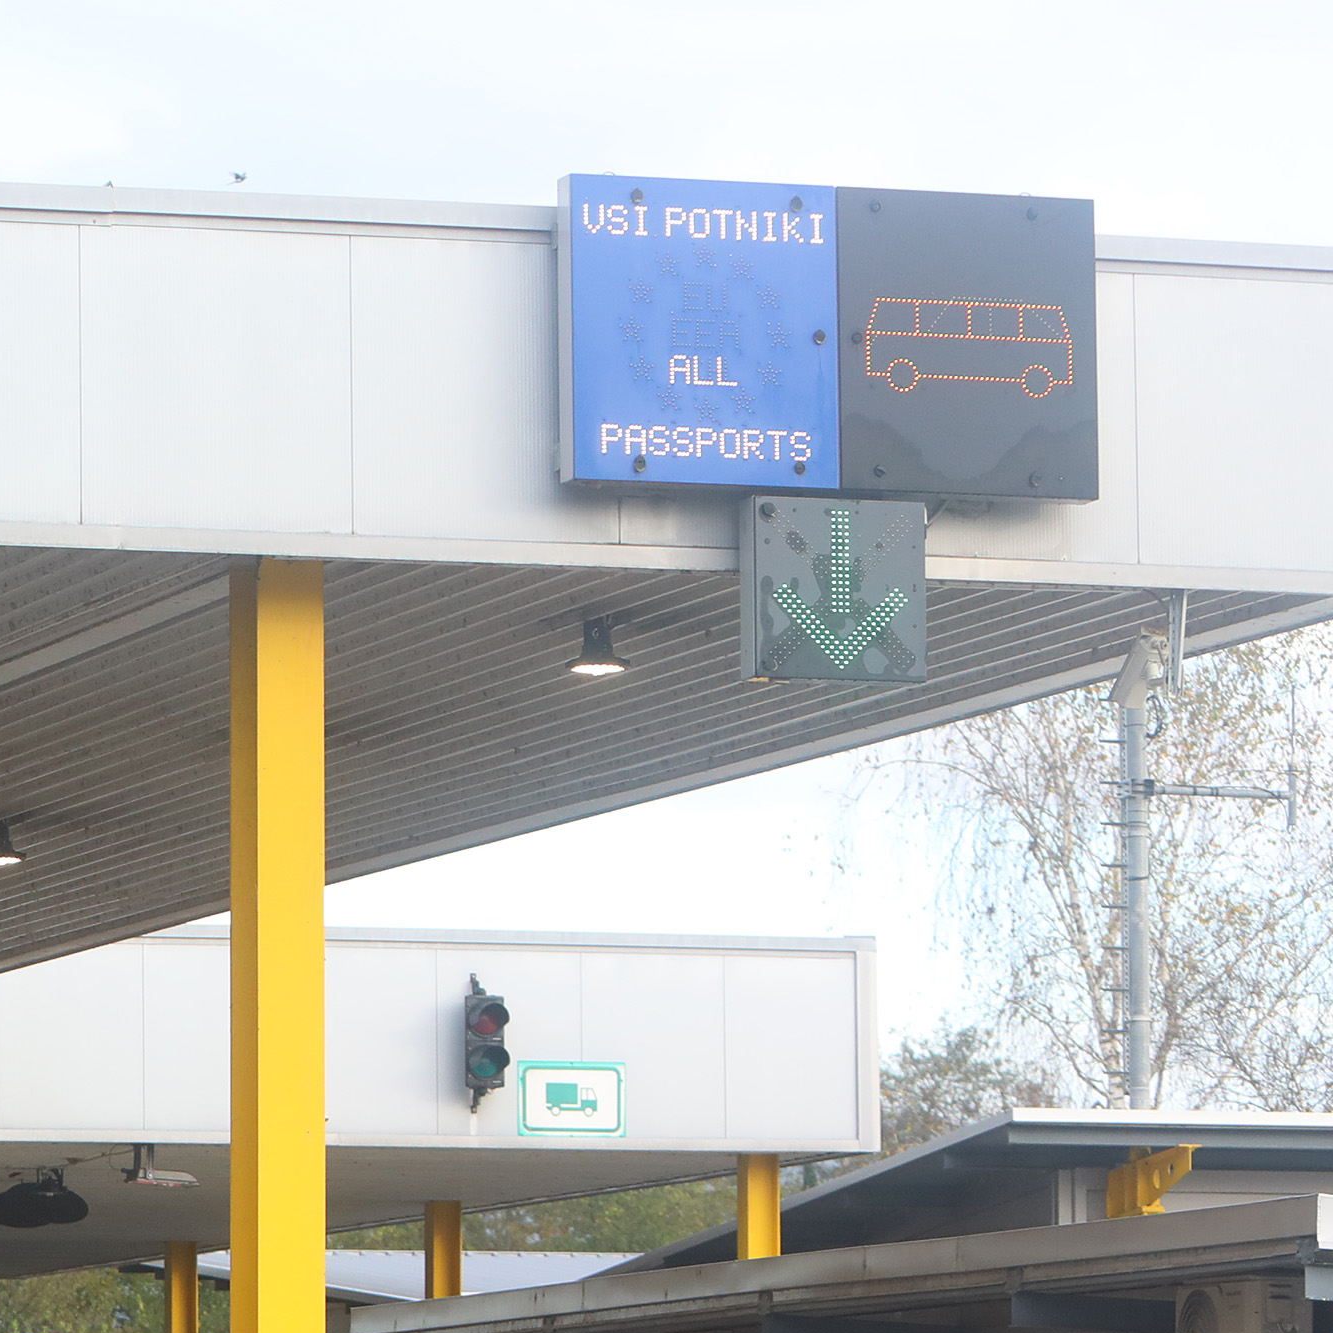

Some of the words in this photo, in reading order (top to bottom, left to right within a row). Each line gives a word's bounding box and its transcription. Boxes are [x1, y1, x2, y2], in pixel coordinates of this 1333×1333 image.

[583, 203, 648, 236] VSI
[665, 207, 824, 245] POTNIKI
[670, 355, 738, 386] ALL
[600, 424, 812, 461] PASSPORTS
